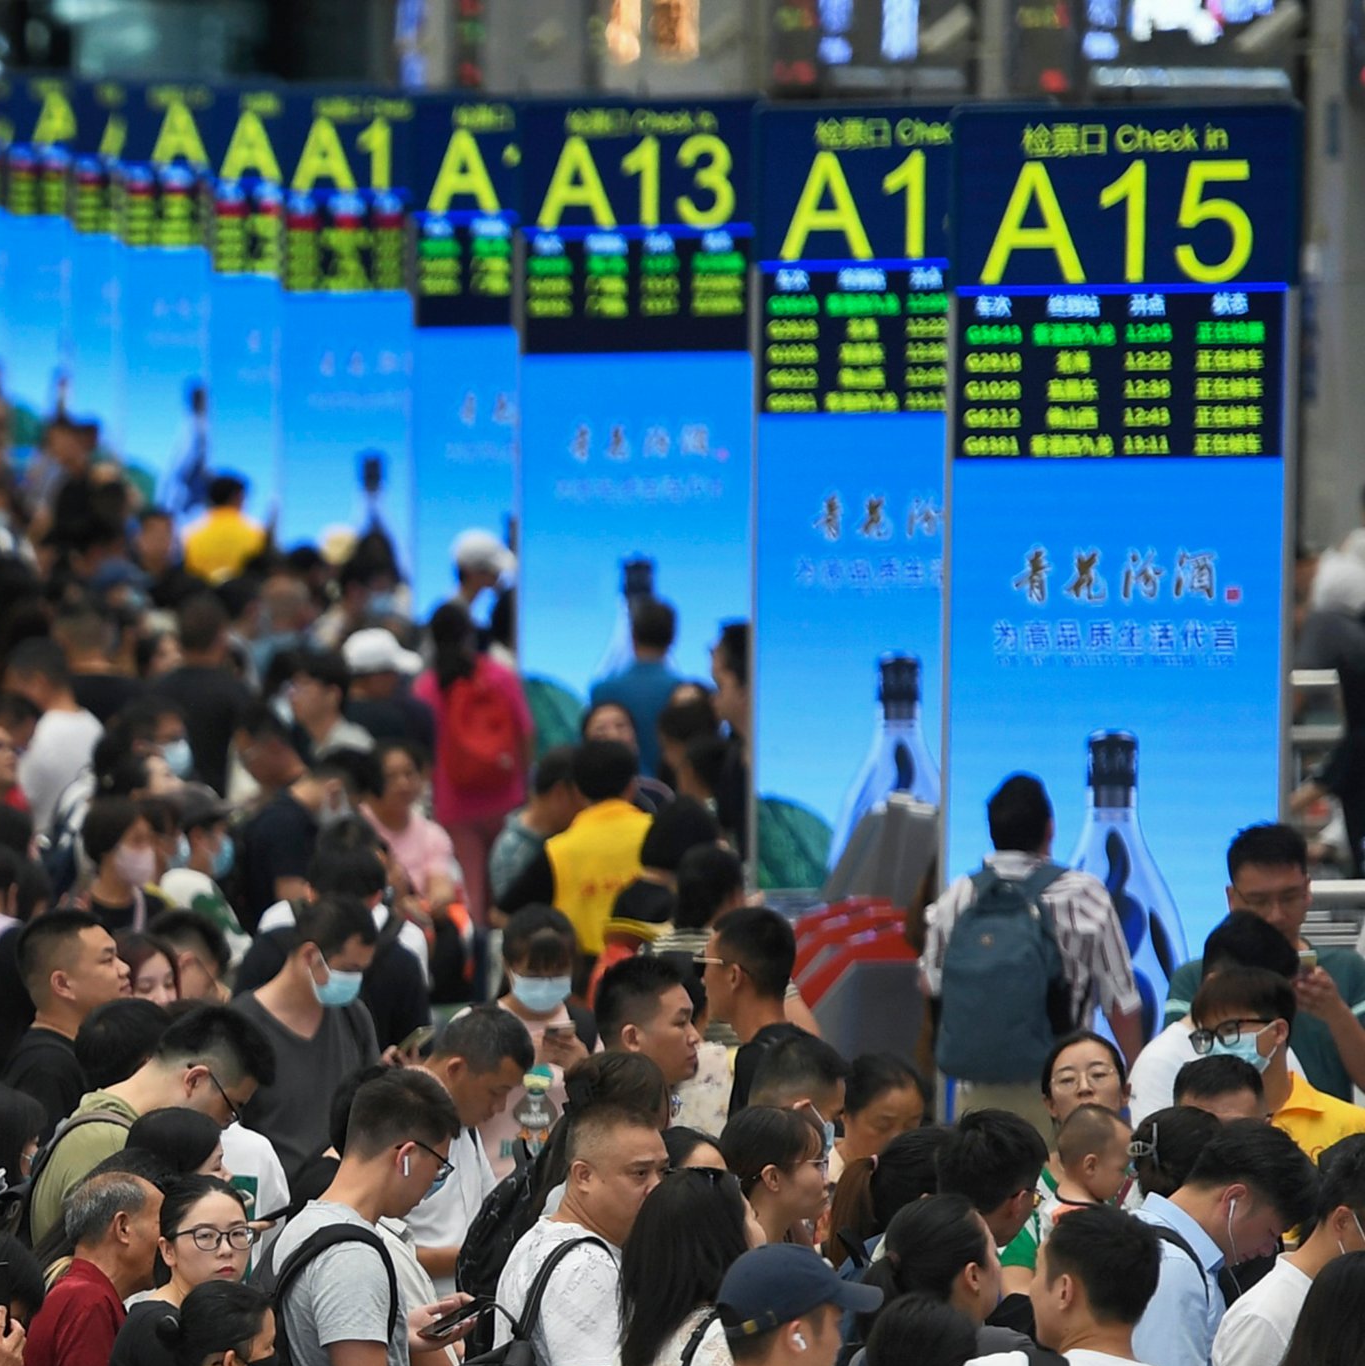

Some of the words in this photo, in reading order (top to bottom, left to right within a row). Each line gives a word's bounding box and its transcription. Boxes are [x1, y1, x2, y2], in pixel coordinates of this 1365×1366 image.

[1022, 123, 1108, 157] 检票口
[1114, 124, 1198, 152] Check
[1203, 123, 1229, 151] in
[537, 134, 736, 229] A13
[779, 149, 948, 260] A1
[979, 159, 1254, 285] A15
[1129, 293, 1166, 316] 开点
[1211, 292, 1249, 316] 状态
[1015, 549, 1216, 602] 青花汾酒
[994, 620, 1237, 649] 为高品质生活代言
